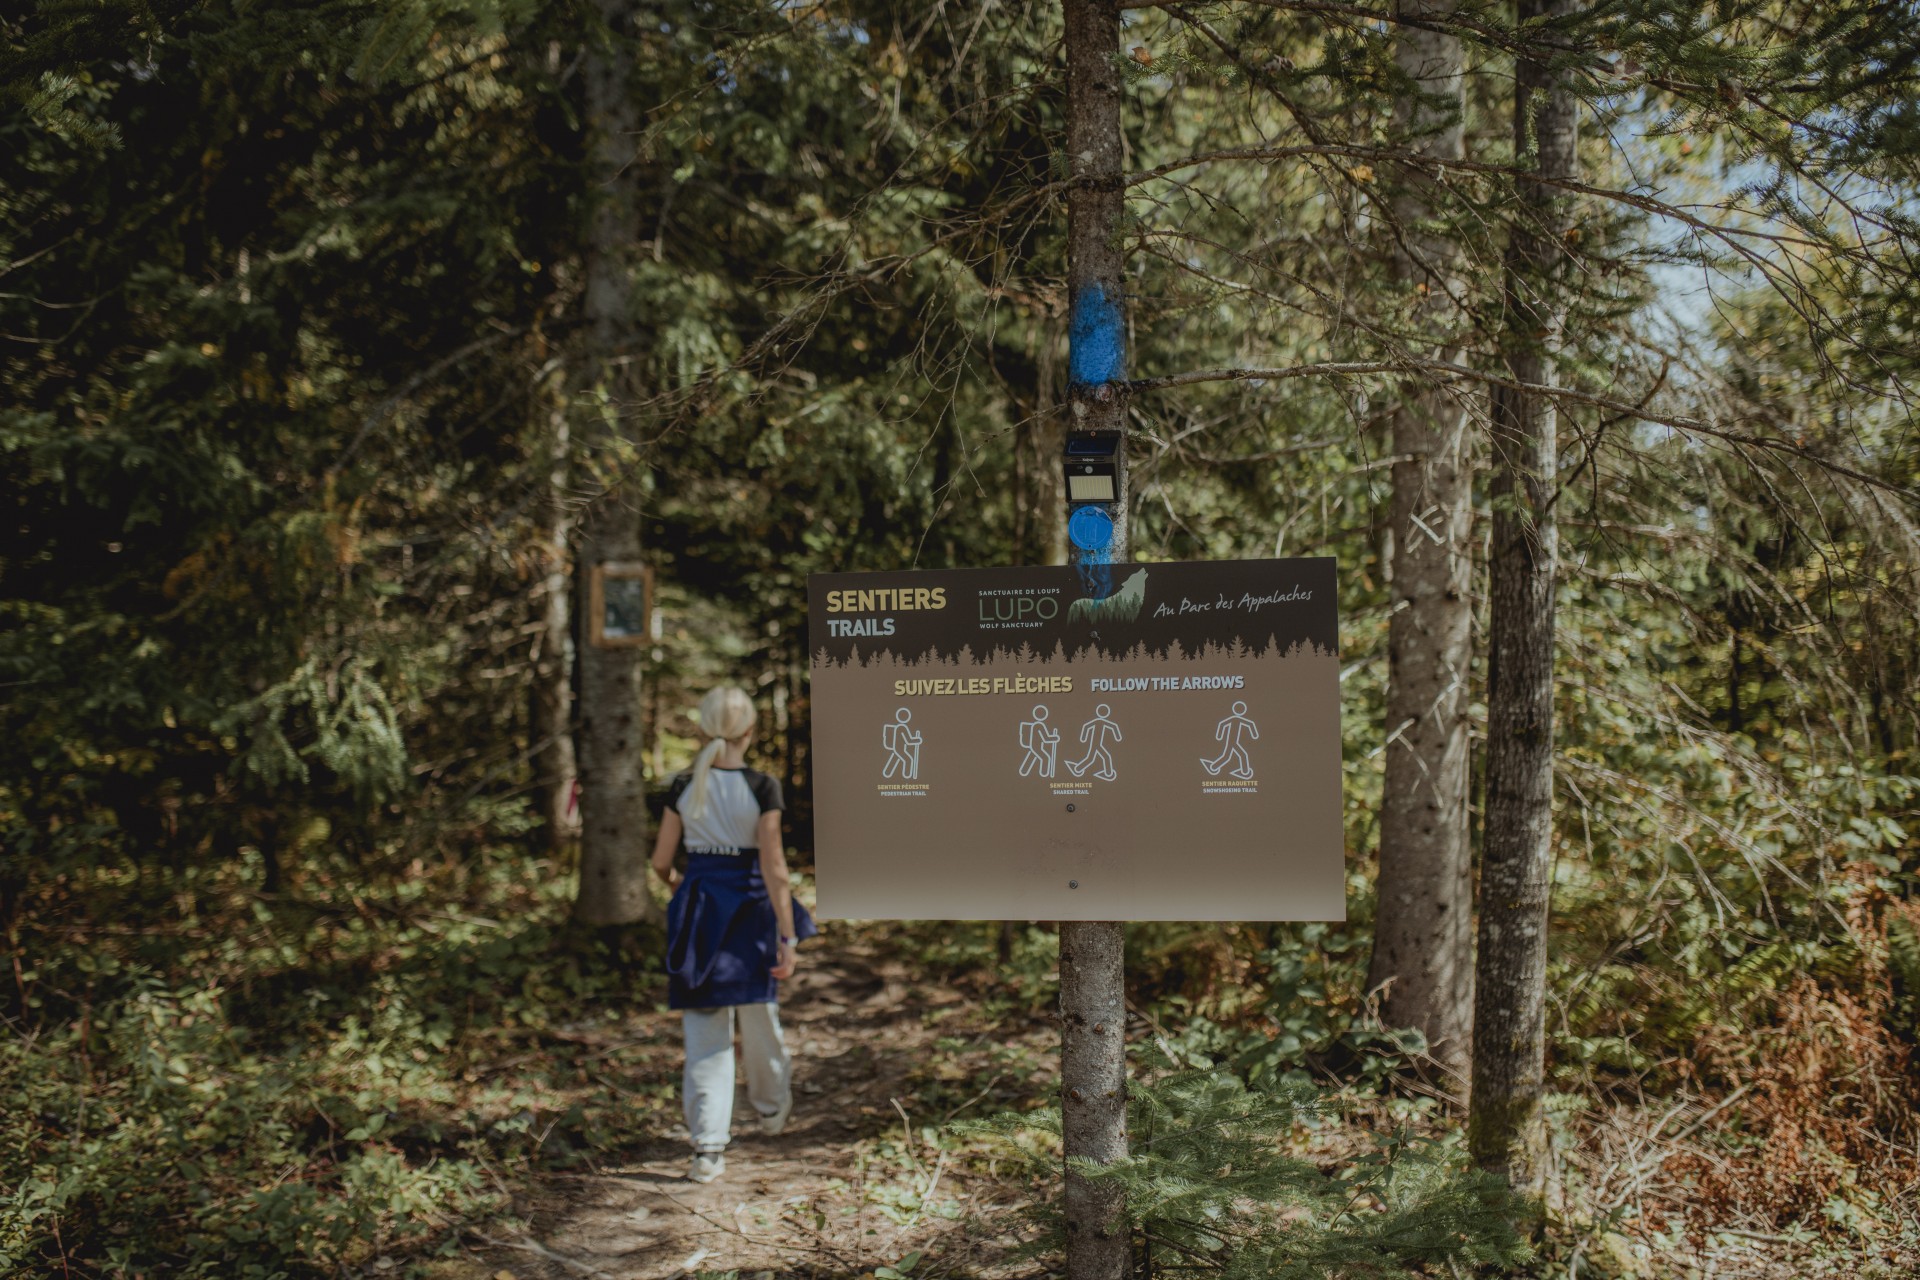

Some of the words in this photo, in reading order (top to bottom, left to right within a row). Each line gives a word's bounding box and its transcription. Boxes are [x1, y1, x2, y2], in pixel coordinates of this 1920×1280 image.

[826, 587, 947, 613] SENTIERS
[979, 596, 1059, 621] LUPO
[1153, 602, 1175, 618] Au
[1179, 597, 1211, 615] Parc
[1215, 593, 1234, 610] des
[1237, 584, 1313, 612] Appalaches
[827, 618, 896, 637] TRAILS
[894, 679, 956, 696] SUIVEZ
[957, 678, 991, 695] LES
[993, 672, 1073, 694] FLÈCHES
[1091, 678, 1149, 692] FOLLOW
[1151, 677, 1180, 690] THE
[1181, 675, 1245, 690] ARROWS
